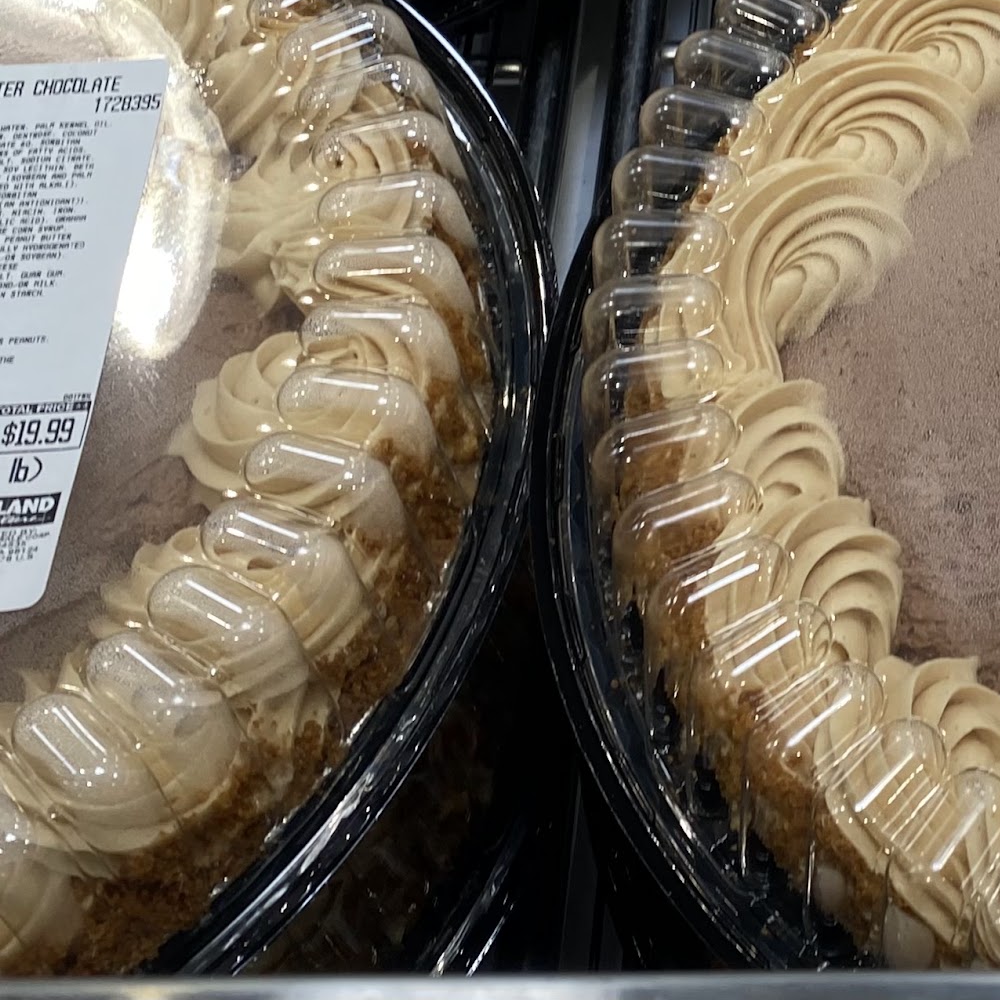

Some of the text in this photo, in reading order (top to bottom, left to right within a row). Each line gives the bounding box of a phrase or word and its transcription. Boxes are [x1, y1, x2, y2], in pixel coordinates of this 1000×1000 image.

[33, 76, 122, 96] CHOCOLATE
[2, 418, 75, 446] $19.99
[8, 456, 43, 484] lb)
